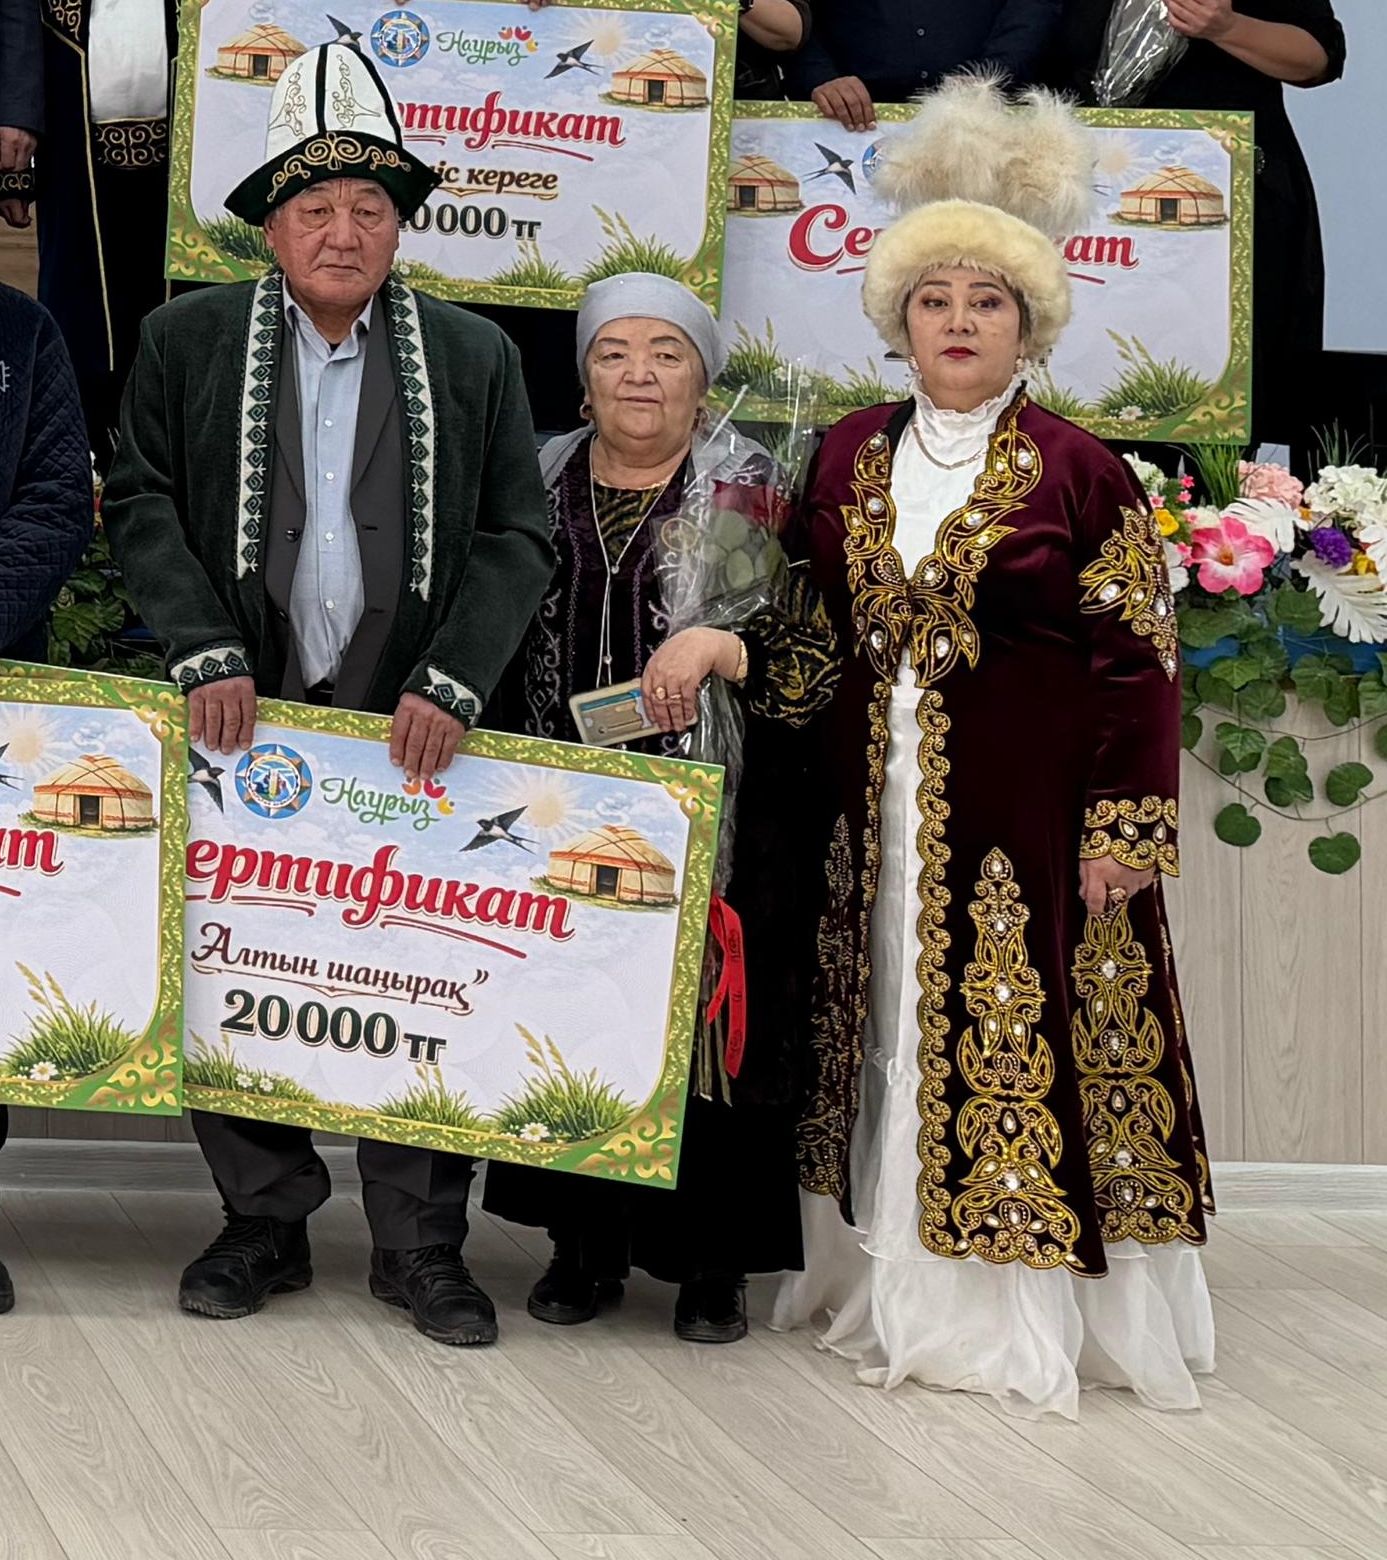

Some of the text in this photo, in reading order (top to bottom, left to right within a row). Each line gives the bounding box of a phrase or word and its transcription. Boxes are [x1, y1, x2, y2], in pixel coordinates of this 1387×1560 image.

[436, 29, 529, 67] Наурыз
[397, 91, 627, 152] тификат
[466, 163, 559, 195] кереге
[320, 775, 441, 832] Наурыз
[191, 921, 320, 978] Алтын
